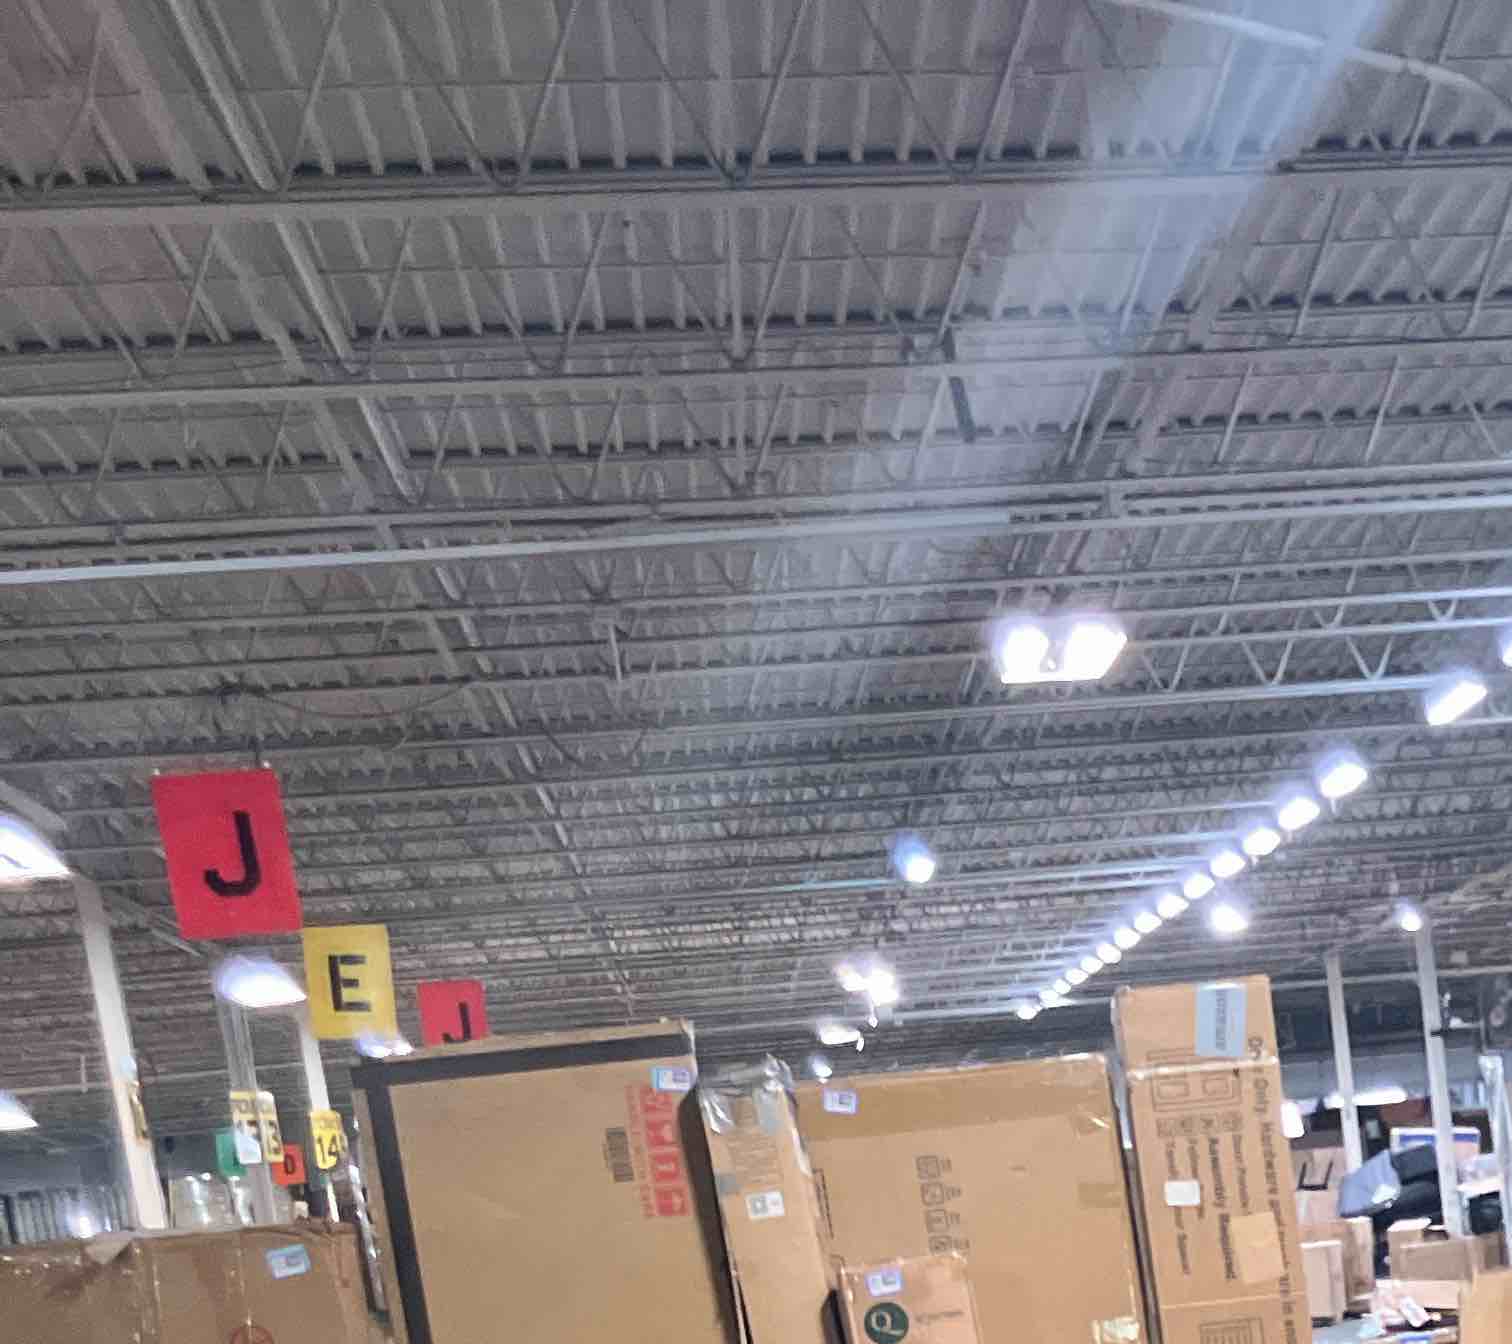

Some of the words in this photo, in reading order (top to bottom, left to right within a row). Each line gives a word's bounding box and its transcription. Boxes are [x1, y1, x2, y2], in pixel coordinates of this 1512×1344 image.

[204, 810, 261, 897] J
[328, 955, 371, 1012] E
[441, 1002, 471, 1043] J
